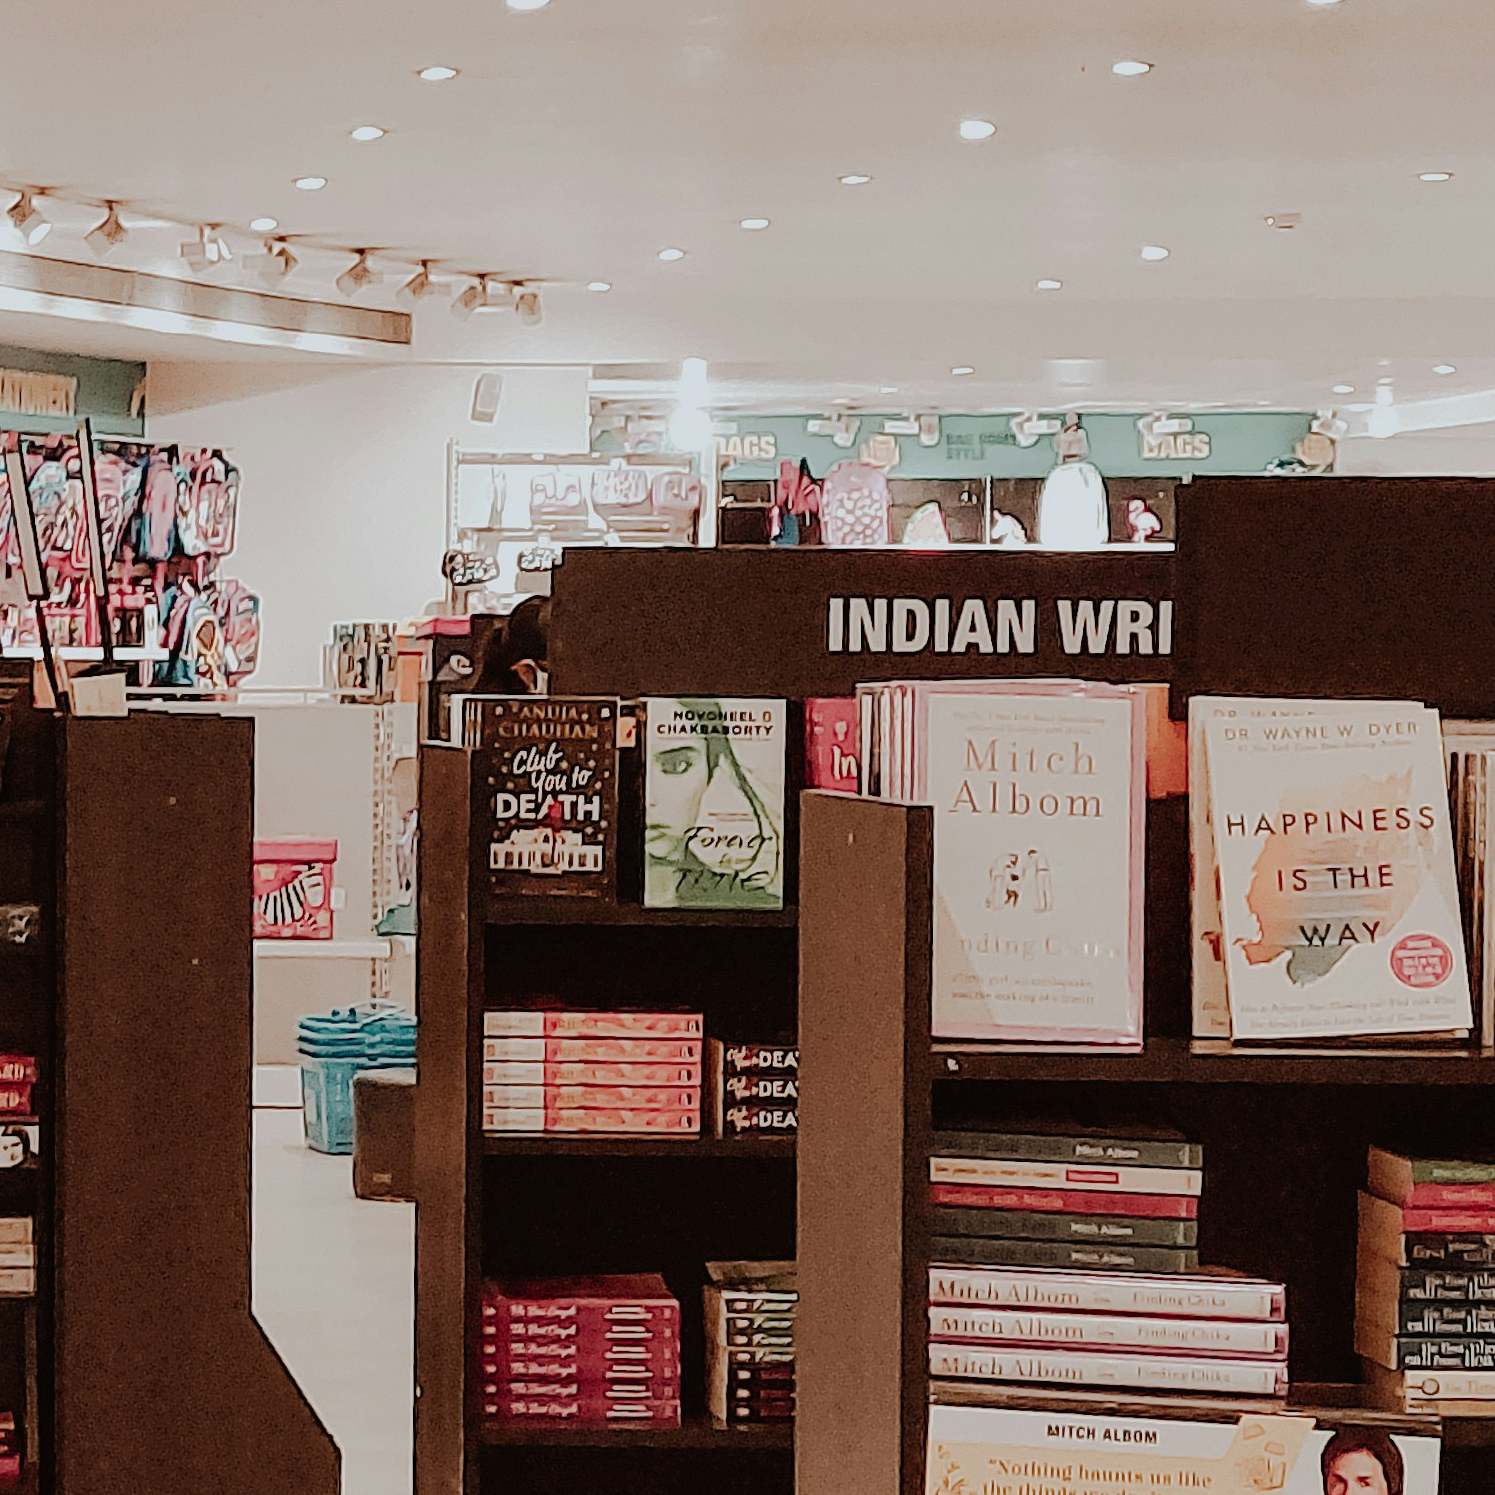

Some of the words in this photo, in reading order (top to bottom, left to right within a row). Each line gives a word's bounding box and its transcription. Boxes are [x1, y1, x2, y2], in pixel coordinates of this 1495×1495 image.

[828, 597, 1034, 654] INDIAN
[1058, 598, 1173, 655] WRI
[1225, 728, 1250, 741] DR
[1264, 725, 1329, 741] WAYNE
[1369, 721, 1419, 737] DYER
[513, 742, 563, 776] Club
[963, 738, 1098, 776] Mitch
[532, 770, 568, 800] You
[572, 766, 593, 789] to
[496, 792, 601, 822] DEATH
[948, 779, 1104, 818] Albom
[1226, 805, 1435, 837] HAPPINESS
[1277, 869, 1309, 892] IS
[1327, 864, 1395, 890] THE
[1299, 921, 1380, 947] WAY
[935, 1279, 1000, 1302] Mitch
[1006, 1282, 1080, 1306] Albom
[941, 1316, 1004, 1336] Mitch
[1009, 1318, 1085, 1340] Albom
[941, 1356, 1004, 1377] Mitch
[1009, 1359, 1085, 1381] Albom
[1047, 1424, 1096, 1441] MITCH
[1103, 1427, 1158, 1444] ALBOM
[1079, 1463, 1144, 1485] haunts
[1178, 1469, 1212, 1489] like
